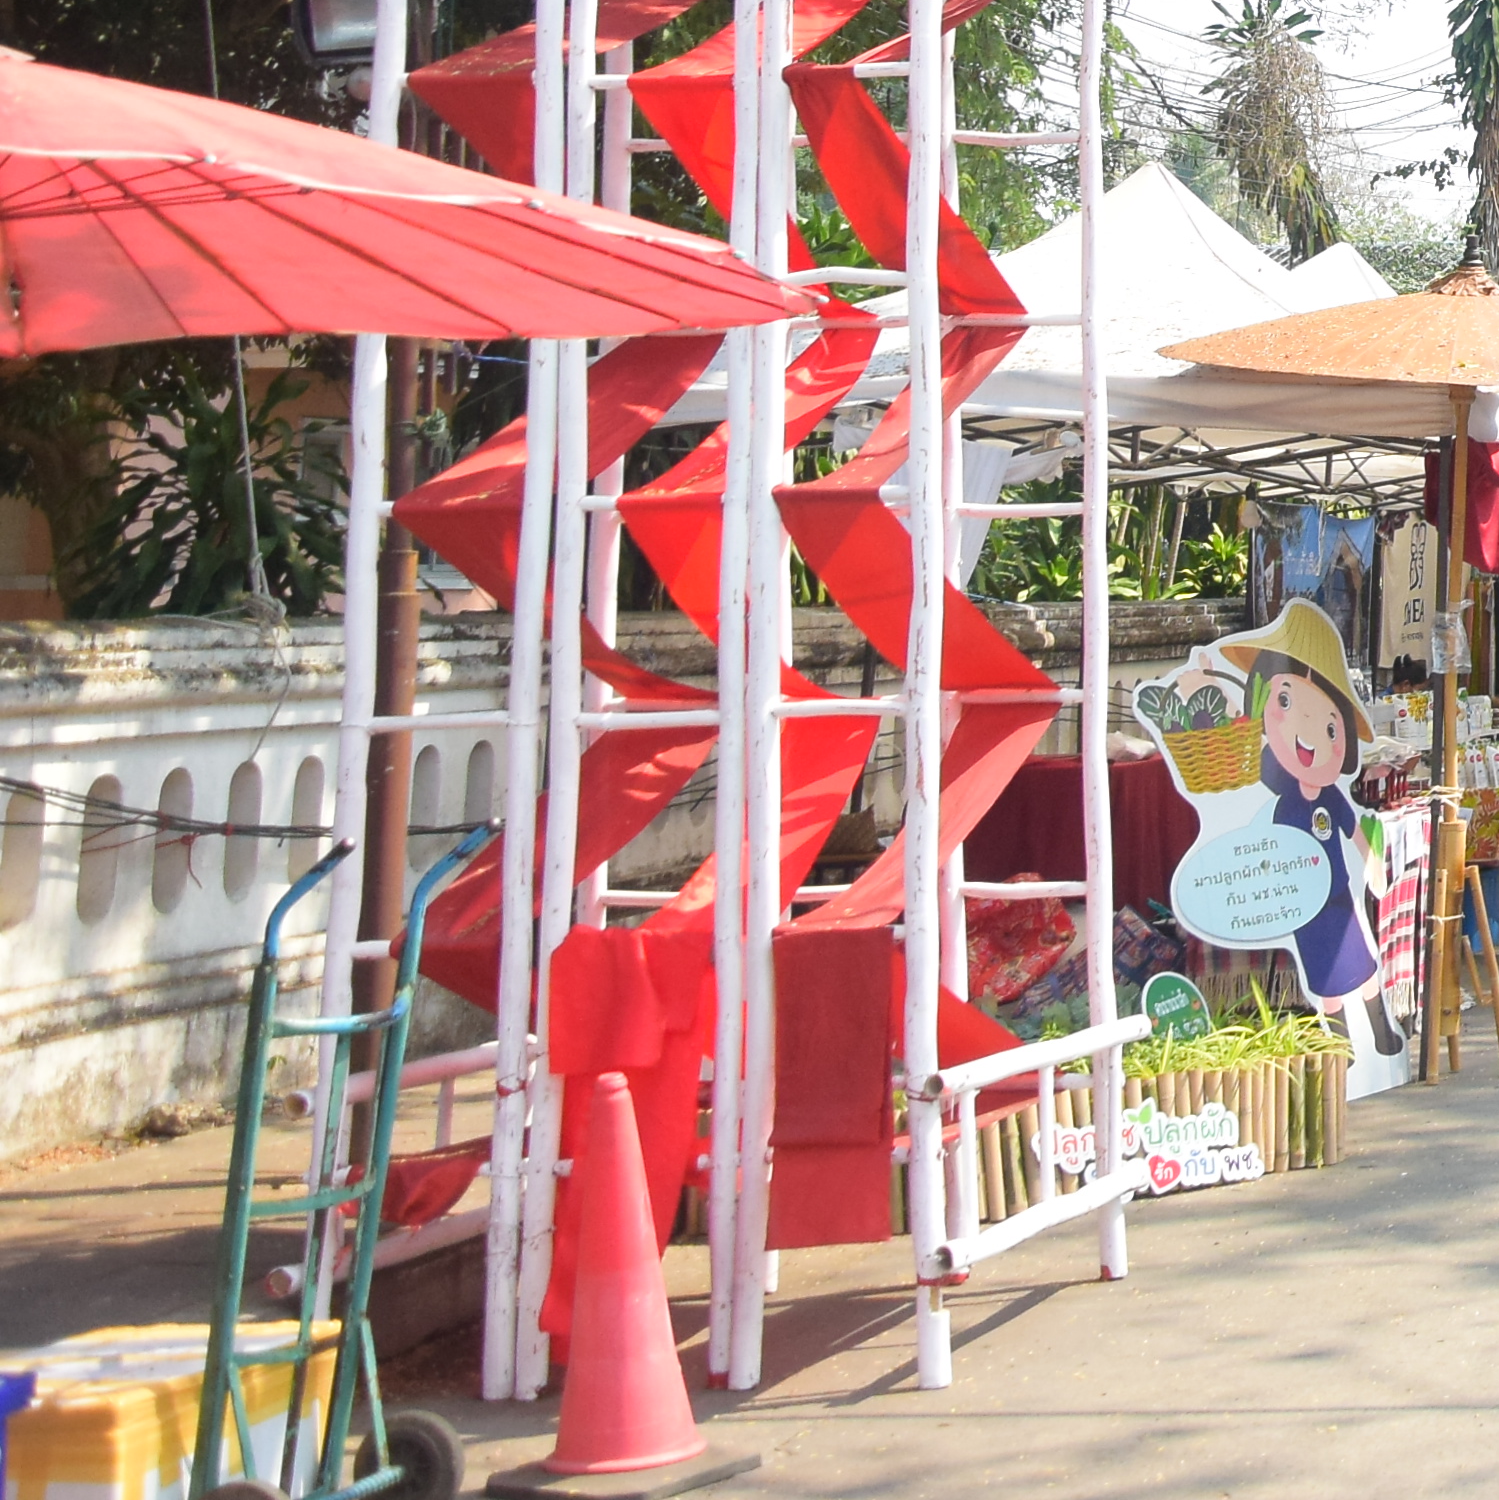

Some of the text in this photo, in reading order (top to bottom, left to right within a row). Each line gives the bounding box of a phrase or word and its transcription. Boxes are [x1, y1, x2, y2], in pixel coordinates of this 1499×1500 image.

[1272, 856, 1312, 876] ปลูกรัก
[1226, 891, 1247, 907] กับ
[1144, 1109, 1233, 1154] ปลูกผัก
[1154, 1150, 1258, 1181] รัก กับ พช.
